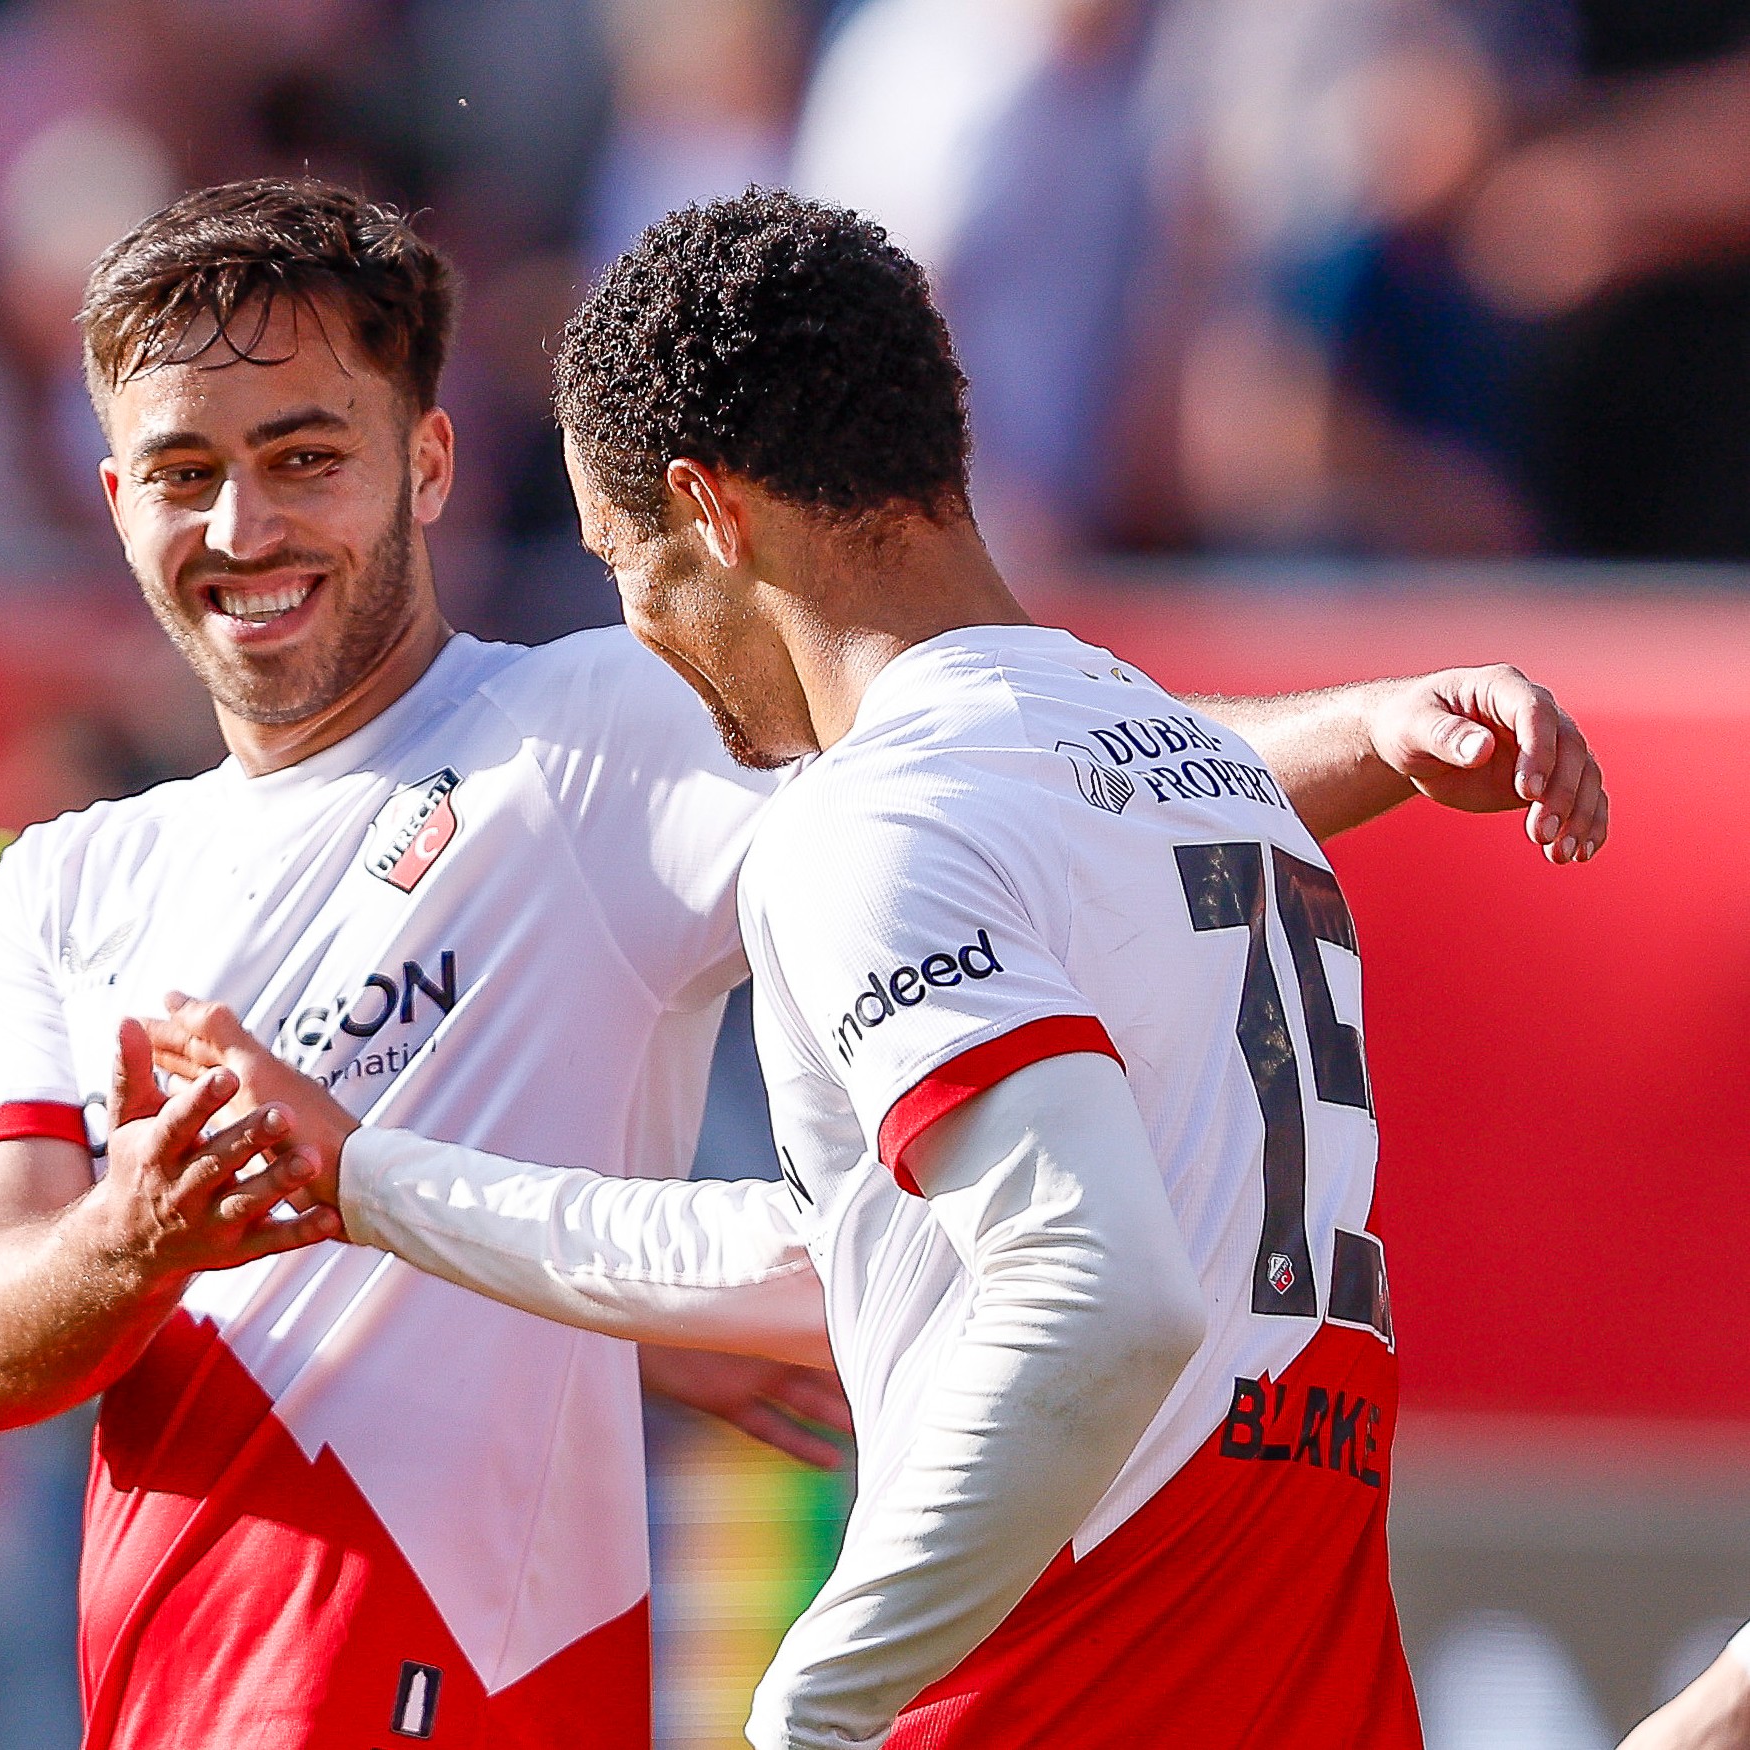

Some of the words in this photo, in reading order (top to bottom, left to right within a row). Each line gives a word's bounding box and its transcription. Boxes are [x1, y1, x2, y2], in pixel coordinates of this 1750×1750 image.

[1088, 716, 1222, 766] DUBAI
[1134, 758, 1287, 803] PROPERT
[827, 928, 1004, 1068] indeed
[1172, 841, 1394, 1342] 15
[1219, 1376, 1381, 1489] BLAKE
